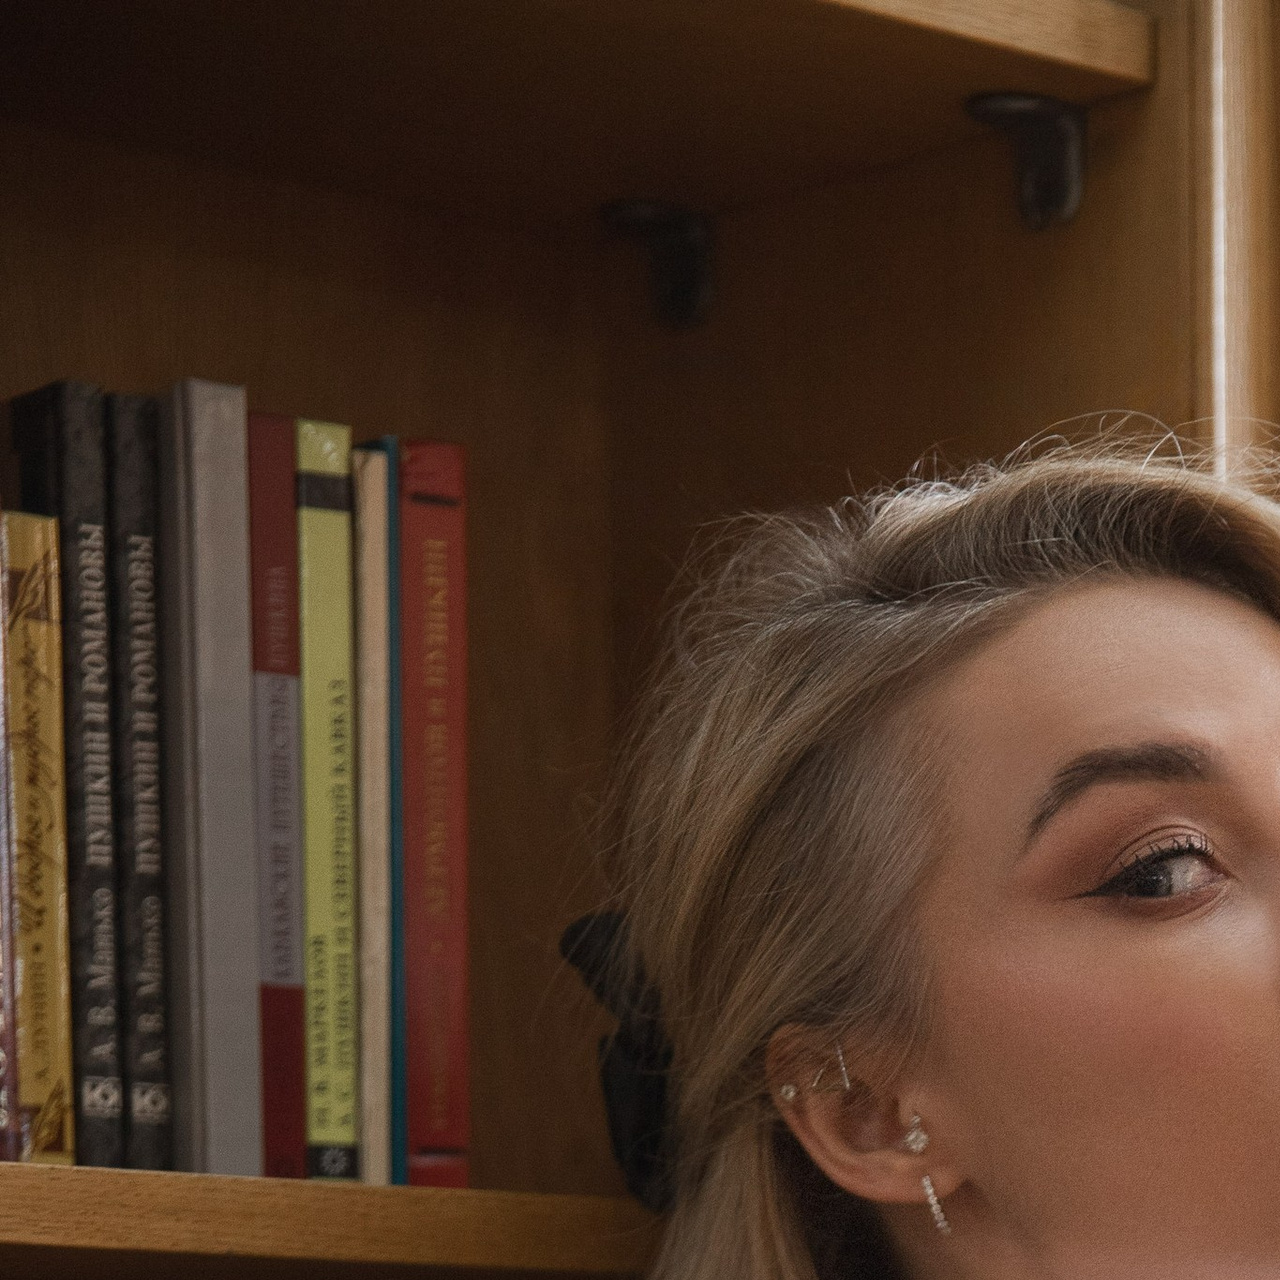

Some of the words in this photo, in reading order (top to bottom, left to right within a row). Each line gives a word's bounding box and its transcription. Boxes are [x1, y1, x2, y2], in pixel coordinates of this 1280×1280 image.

[78, 523, 107, 693] РОМАНОВЫ
[127, 534, 156, 703] РОМАНОВЫ
[421, 539, 449, 688] ПУШКИН
[81, 700, 109, 723] И
[131, 710, 157, 732] И
[327, 678, 348, 776] КАВКАЗ
[83, 731, 112, 868] ПУШКИН
[133, 740, 160, 875] ПУШКИН
[86, 887, 115, 990] Манько
[135, 895, 162, 997] Манько
[88, 998, 115, 1026] В.
[90, 1035, 116, 1065] А.
[139, 1044, 164, 1071] А.
